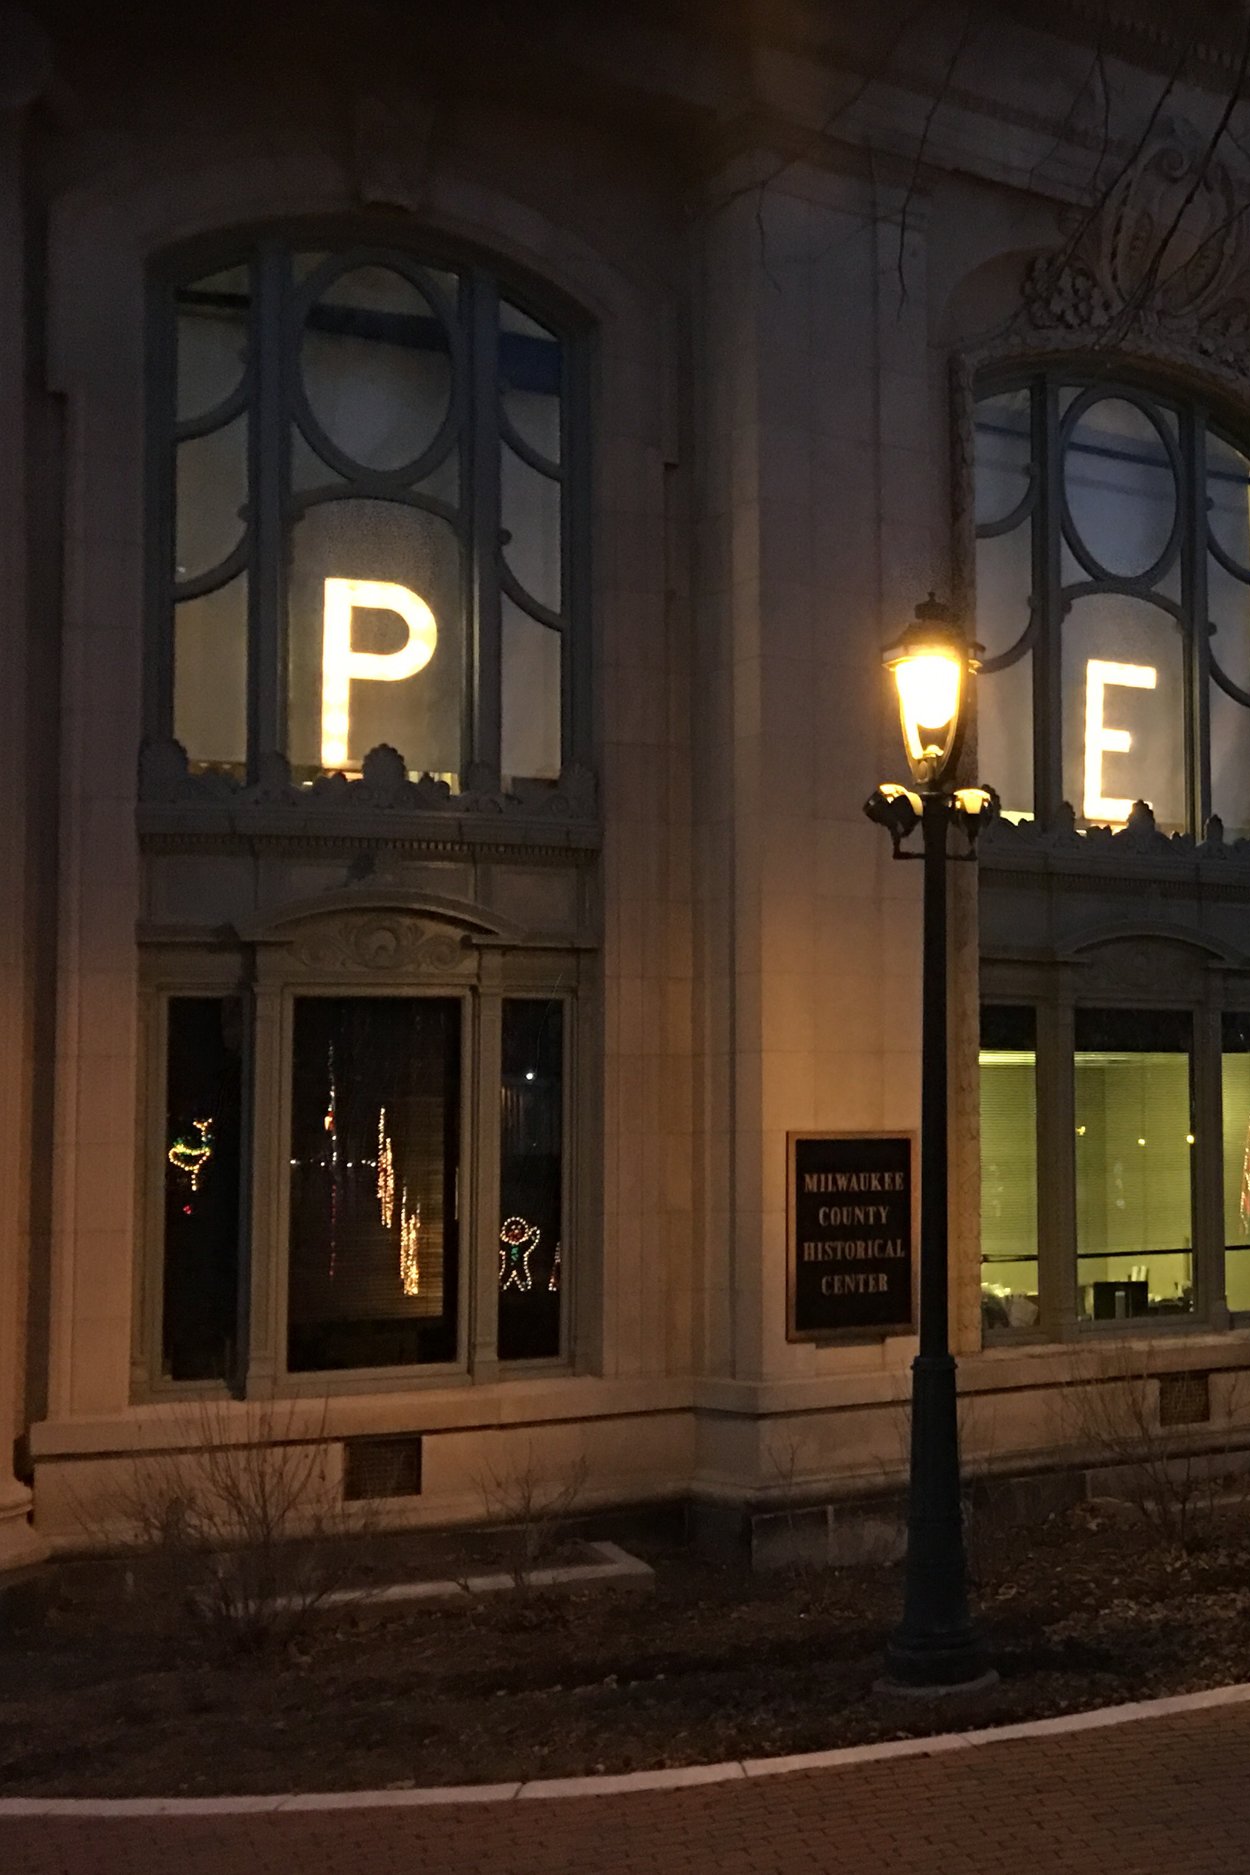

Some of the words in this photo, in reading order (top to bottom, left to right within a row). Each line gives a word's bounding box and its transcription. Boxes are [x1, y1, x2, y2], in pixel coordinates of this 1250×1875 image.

[321, 577, 438, 770] P
[1082, 658, 1158, 824] E
[803, 1172, 905, 1193] MILWAUKEE
[818, 1206, 889, 1227] COUNTY
[803, 1239, 905, 1262] HISTORICAL
[821, 1273, 888, 1295] CENTER
